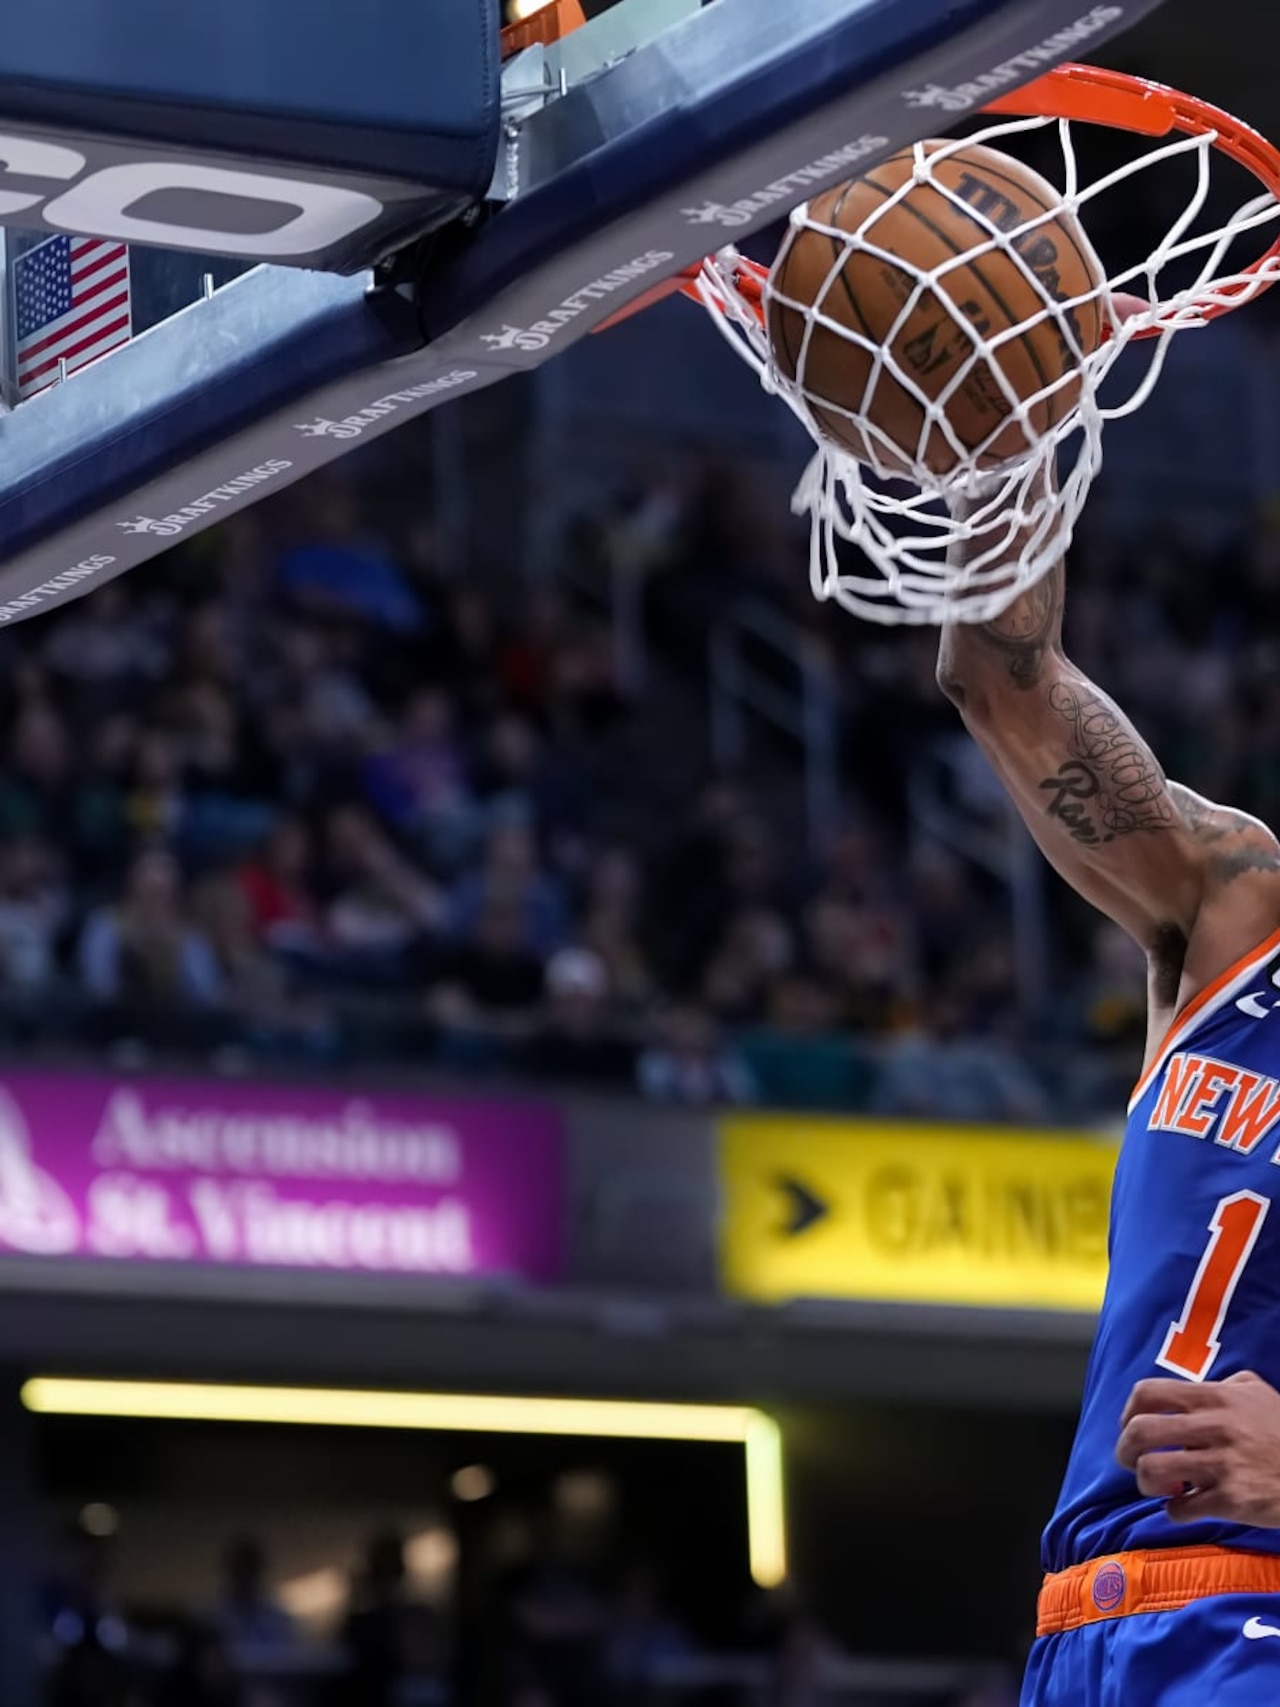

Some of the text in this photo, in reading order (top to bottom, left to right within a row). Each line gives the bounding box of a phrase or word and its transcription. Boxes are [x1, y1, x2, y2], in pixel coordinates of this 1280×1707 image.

[715, 134, 889, 226] DRAFTKINGS
[514, 250, 674, 350] DRAFTKINGS
[328, 369, 478, 438] DRAFTKINGS
[149, 458, 293, 536] DRAFTKINGS
[1156, 1189, 1270, 1382] 1
